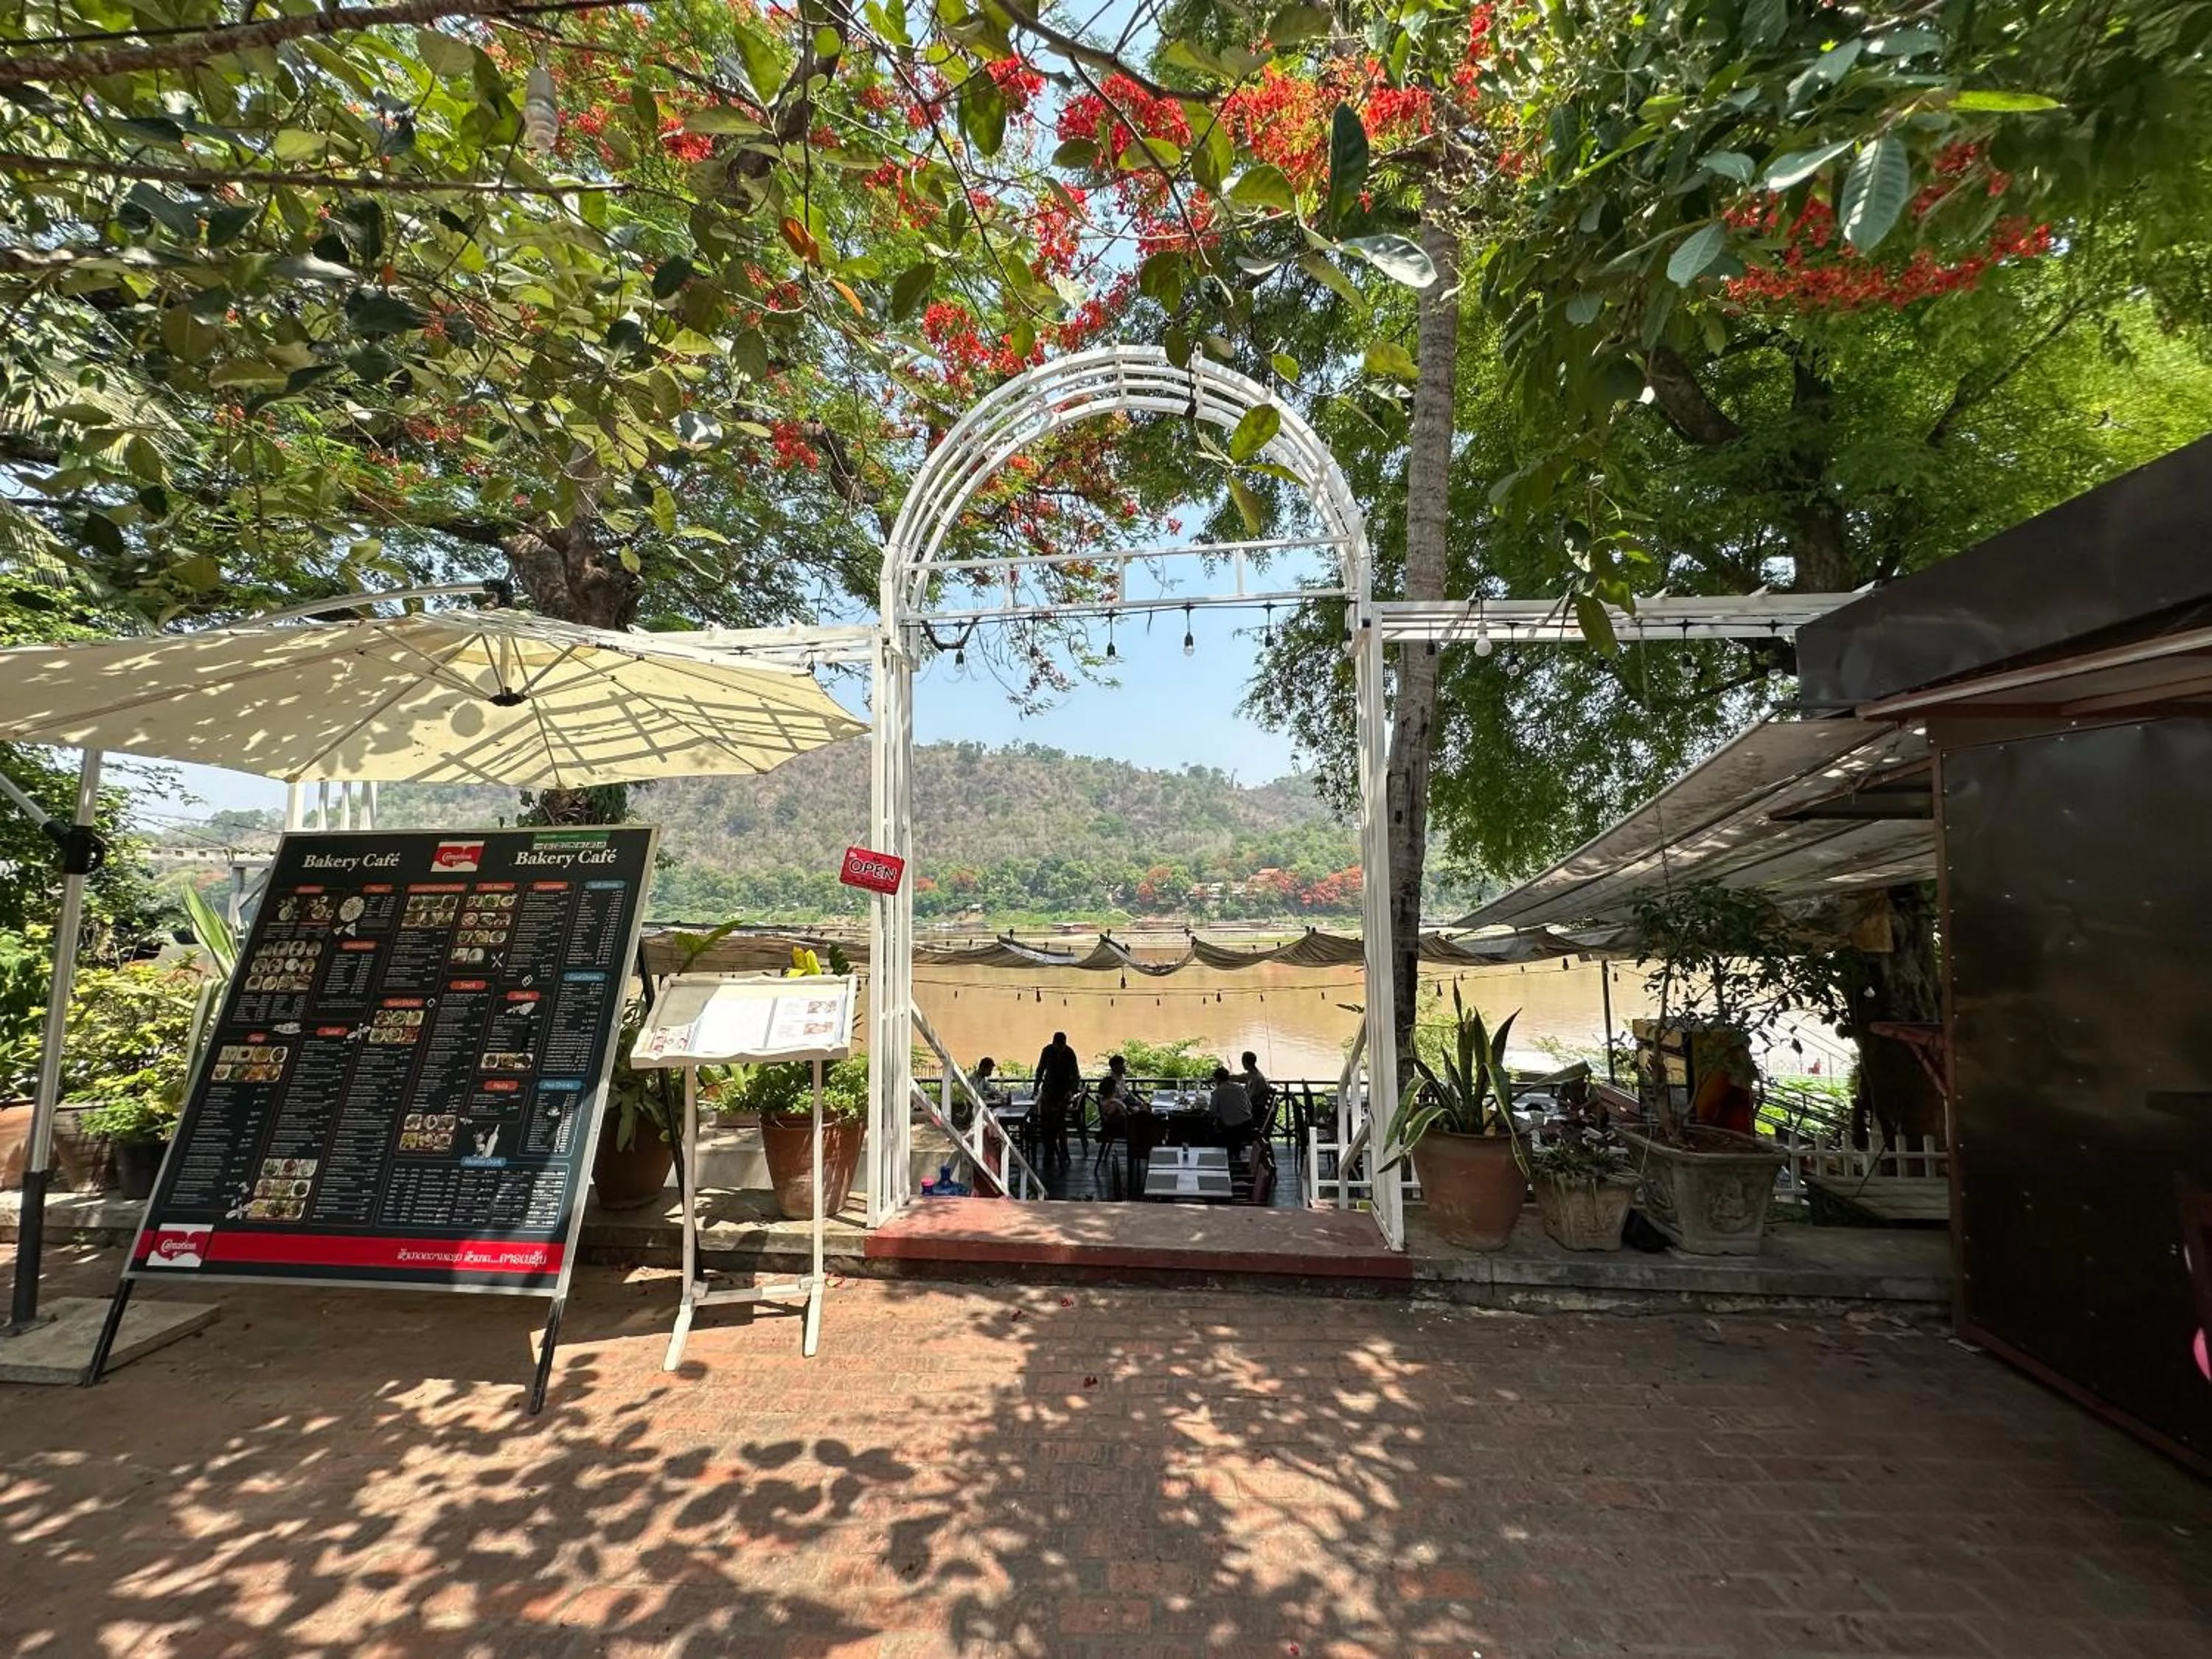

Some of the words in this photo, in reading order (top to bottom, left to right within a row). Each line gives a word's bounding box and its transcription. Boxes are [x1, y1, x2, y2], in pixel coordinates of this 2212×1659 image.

[302, 854, 360, 872] Bakery
[363, 852, 400, 867] Café
[514, 851, 574, 869] Bakery
[577, 849, 617, 863] Café
[849, 858, 897, 883] OPEN
